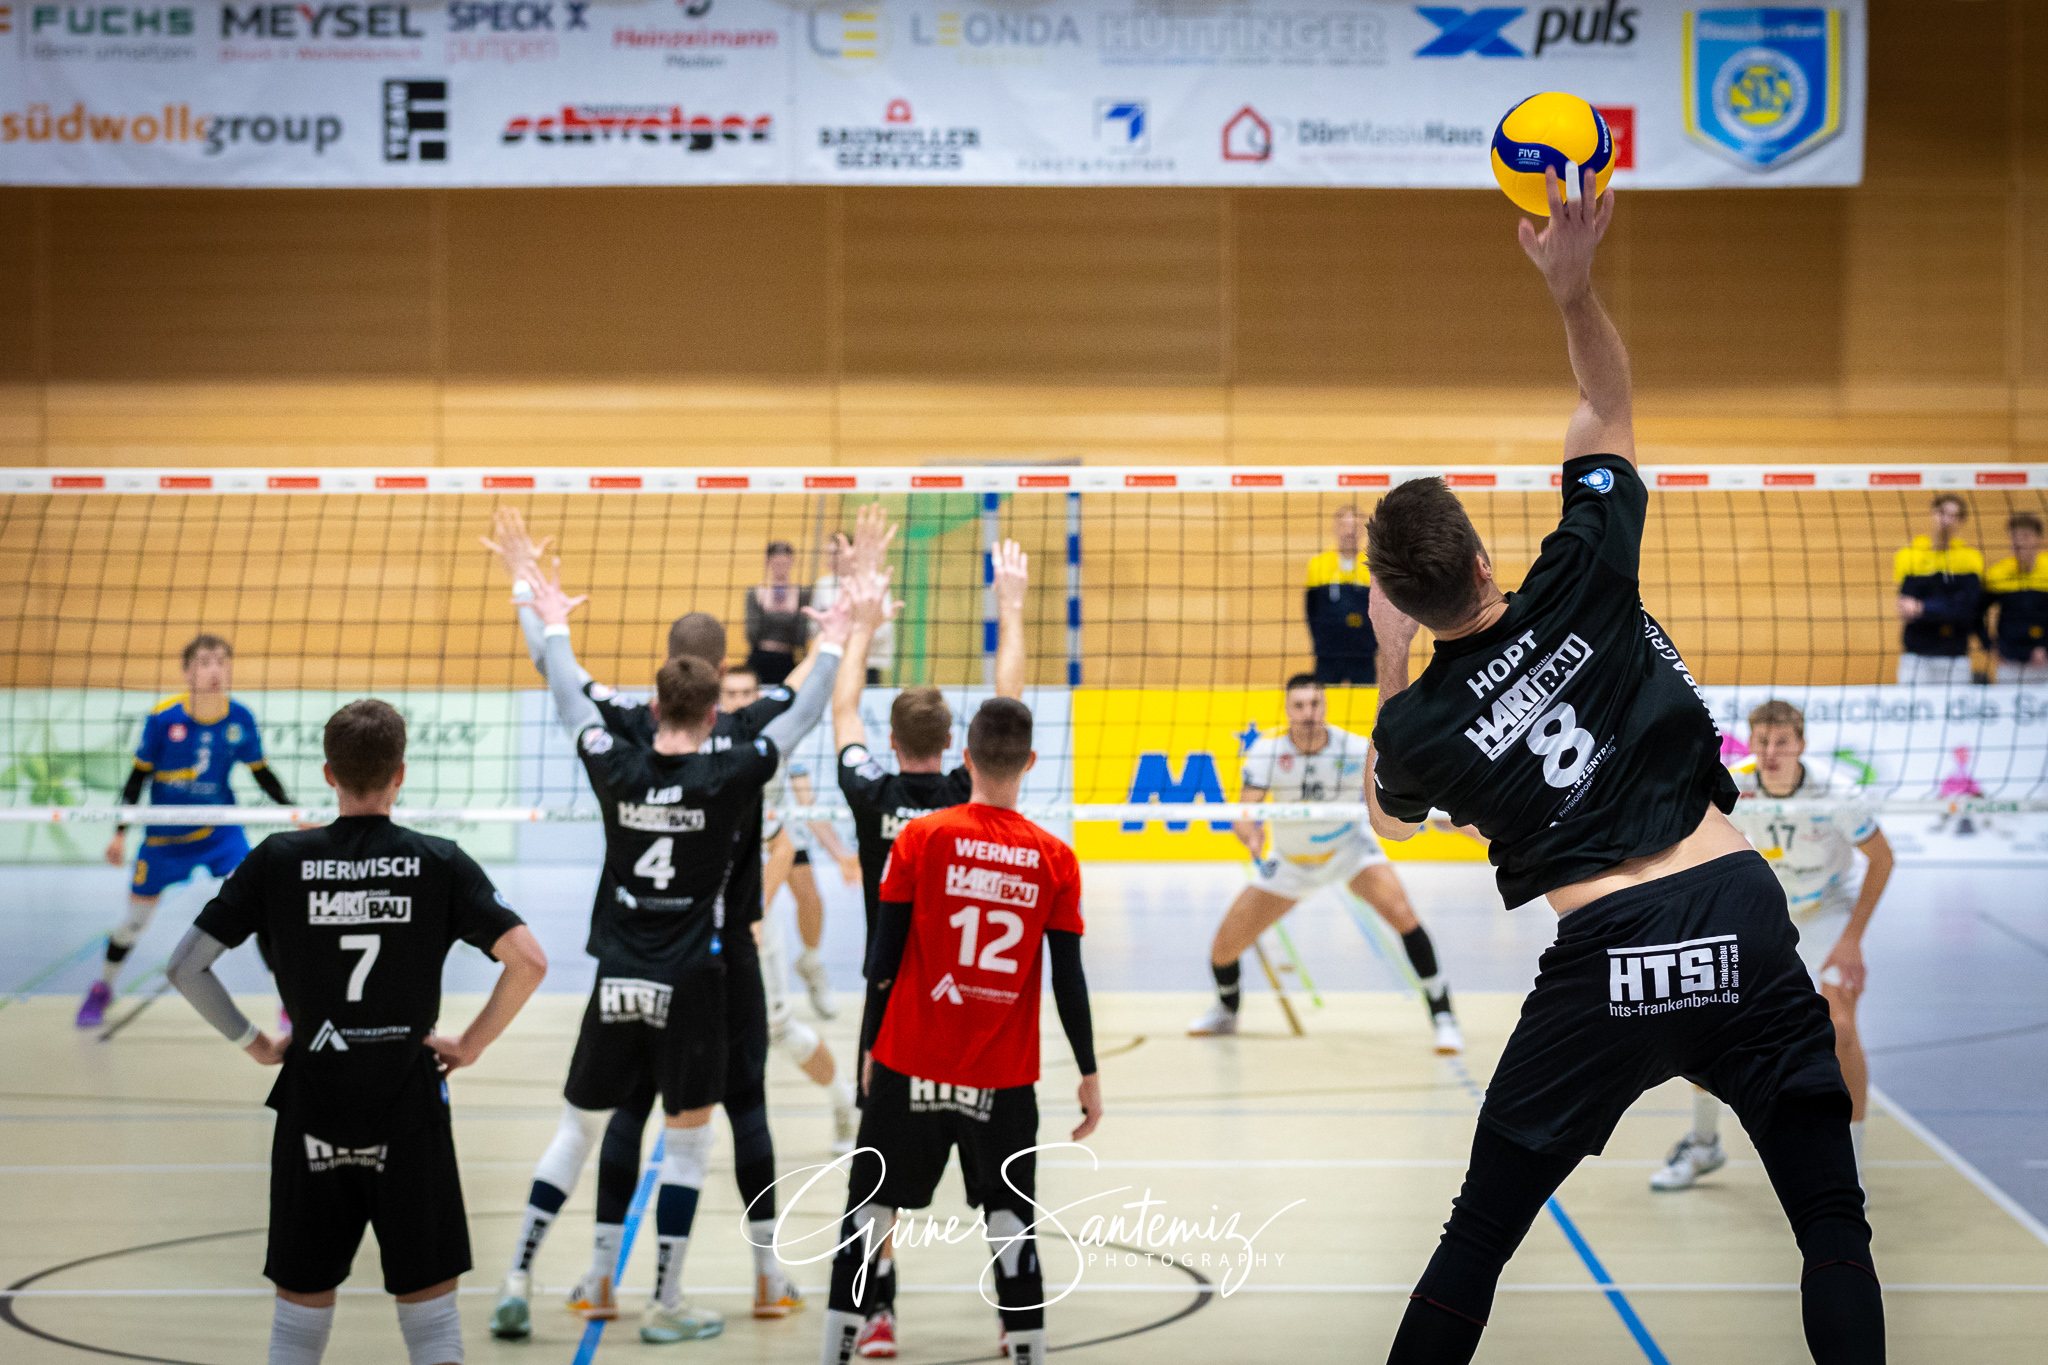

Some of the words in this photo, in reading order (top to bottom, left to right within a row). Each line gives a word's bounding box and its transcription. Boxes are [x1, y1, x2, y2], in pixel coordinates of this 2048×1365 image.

[32, 6, 196, 35] FUCHS
[221, 4, 425, 39] MEYSEL
[1535, 0, 1640, 58] puls
[1518, 148, 1541, 159] FIVB
[1466, 629, 1538, 700] HOPT
[1528, 652, 1552, 676] GmbH
[1464, 674, 1541, 754] HART
[1525, 701, 1596, 788] 8
[955, 837, 1040, 869] WERNER
[1766, 824, 1795, 851] 17
[302, 857, 420, 880] BIERWISCH
[633, 836, 676, 890] 4
[949, 905, 1024, 974] 12
[340, 934, 380, 1001] 7
[1610, 948, 1716, 1002] HTS
[1719, 945, 1729, 988] Frankenbau
[1609, 990, 1740, 1017] hts-frankenbau.de
